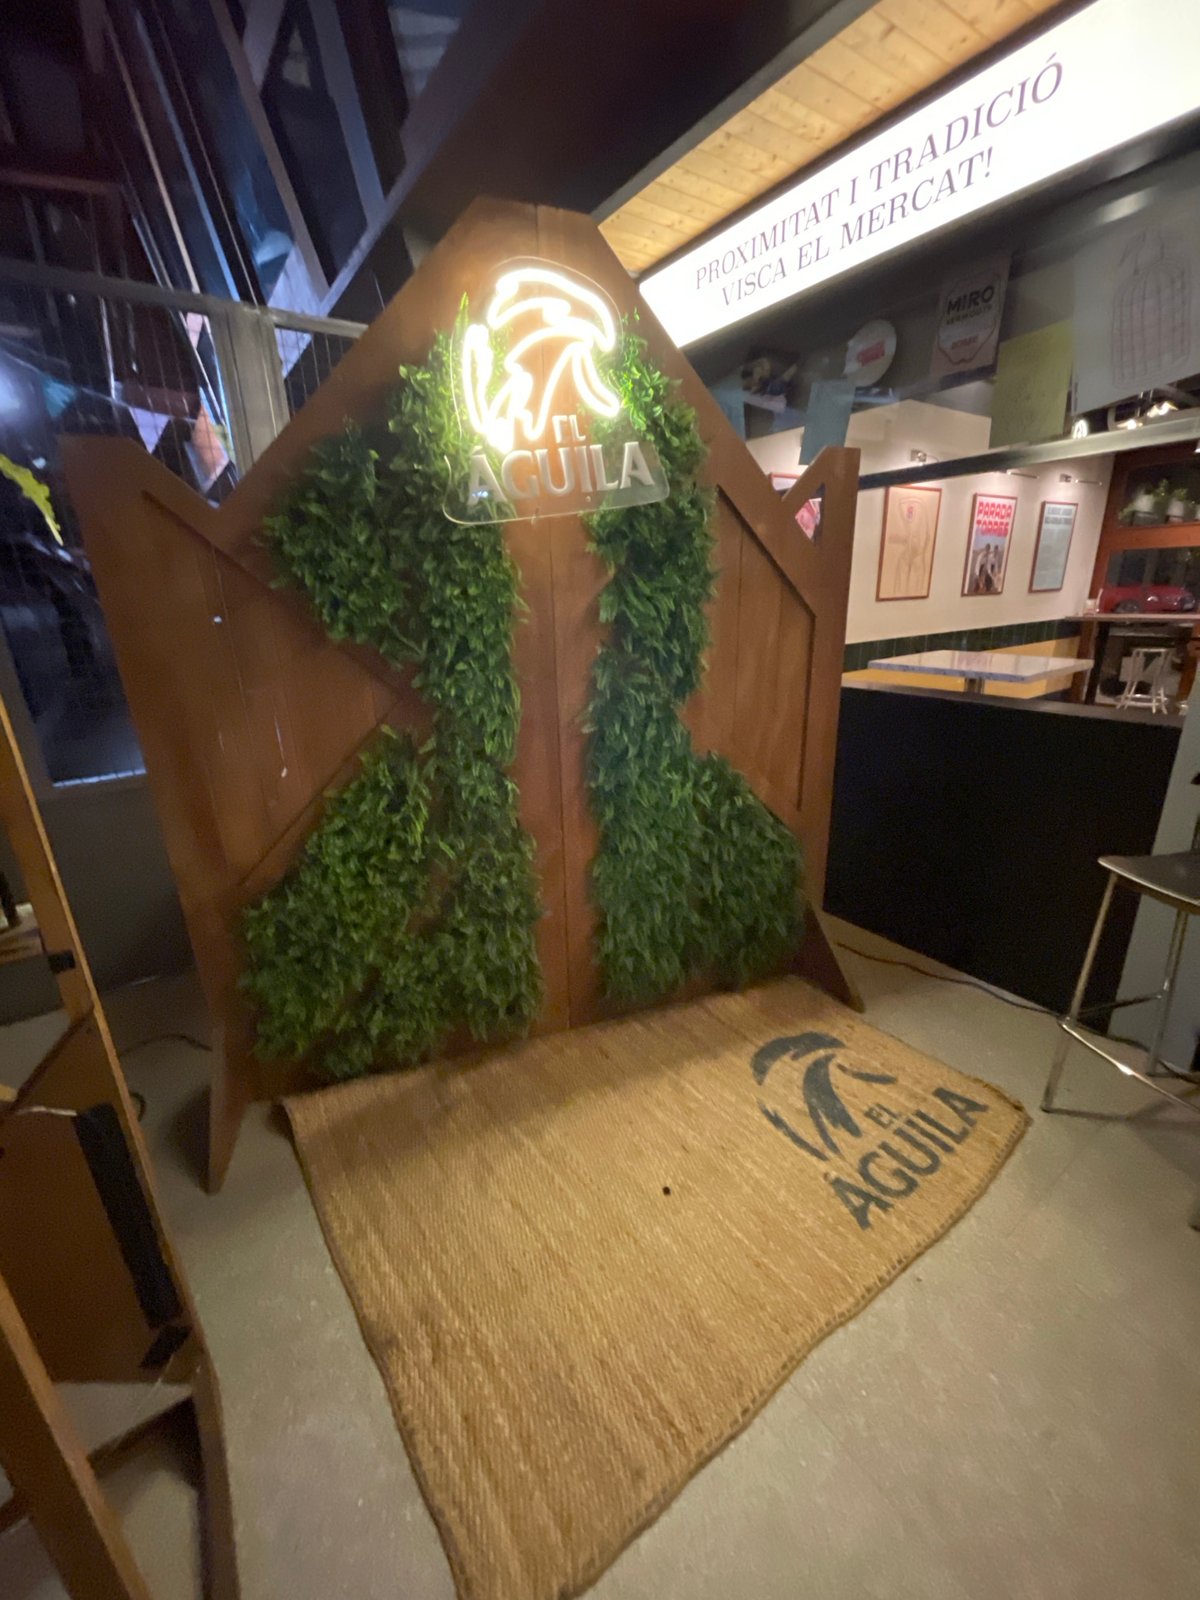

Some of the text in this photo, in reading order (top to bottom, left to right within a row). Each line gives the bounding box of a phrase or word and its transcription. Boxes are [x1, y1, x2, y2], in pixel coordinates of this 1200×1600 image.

[696, 53, 1064, 289] PROXIMITAT I TRADICIÓ
[721, 146, 994, 306] VISCA EL MERCAT!
[946, 285, 994, 315] MIRO
[552, 414, 586, 444] EL
[864, 1103, 900, 1129] EL
